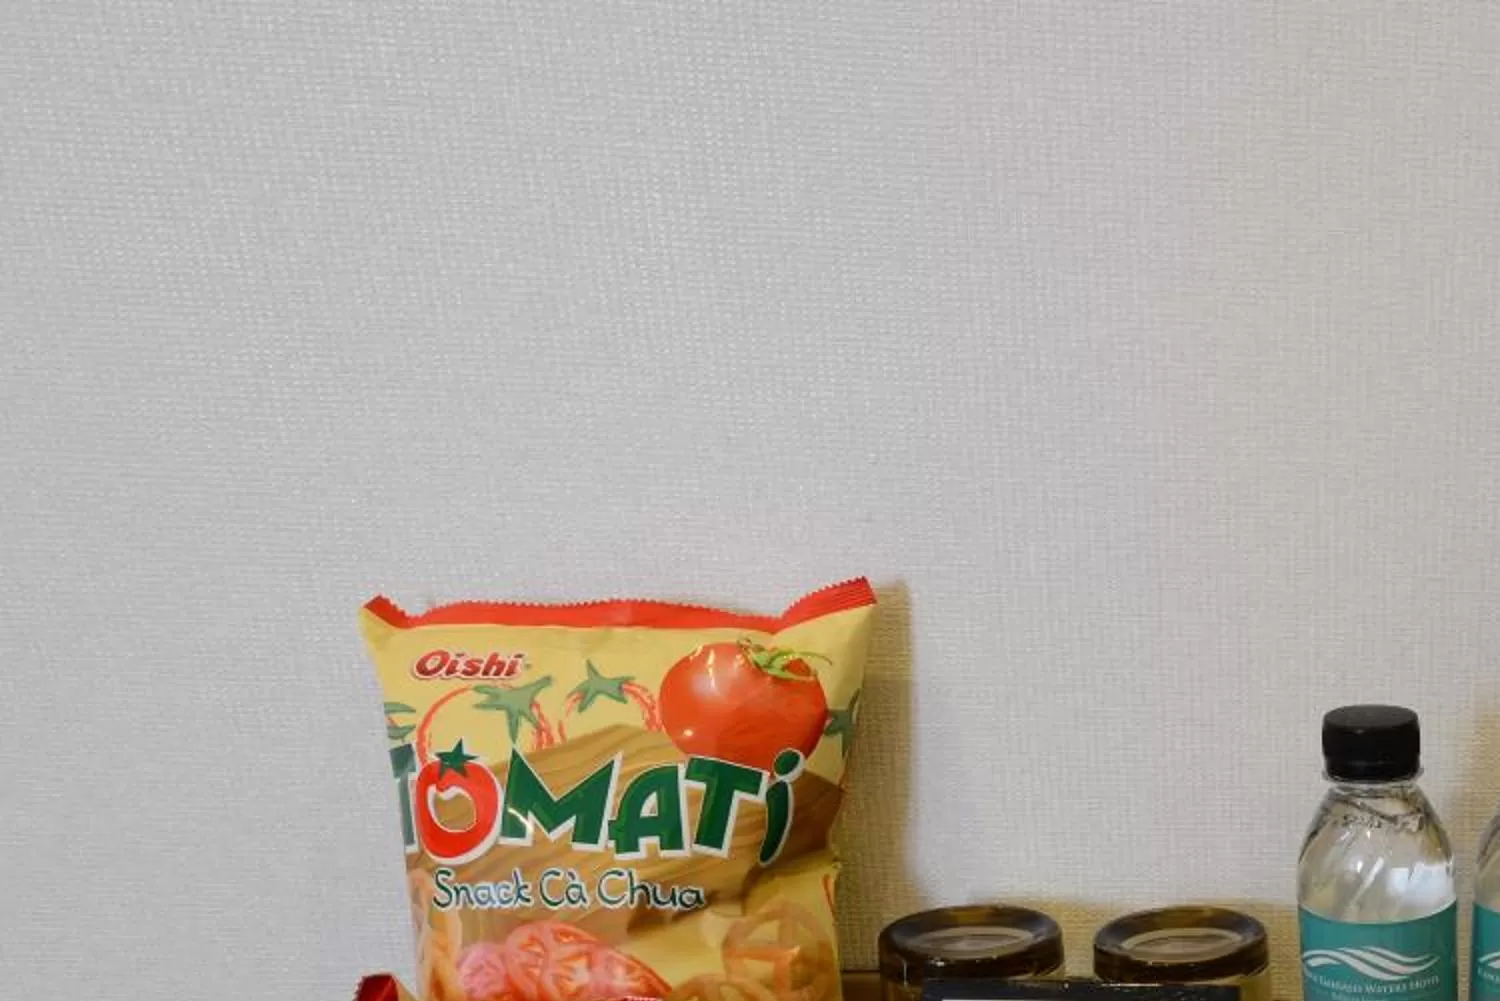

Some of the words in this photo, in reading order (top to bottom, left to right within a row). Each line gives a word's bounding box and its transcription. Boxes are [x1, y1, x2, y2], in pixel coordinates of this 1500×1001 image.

[412, 649, 524, 681] Oishi
[433, 870, 532, 910] Snack
[539, 871, 587, 910] Cà
[598, 870, 707, 910] Chua
